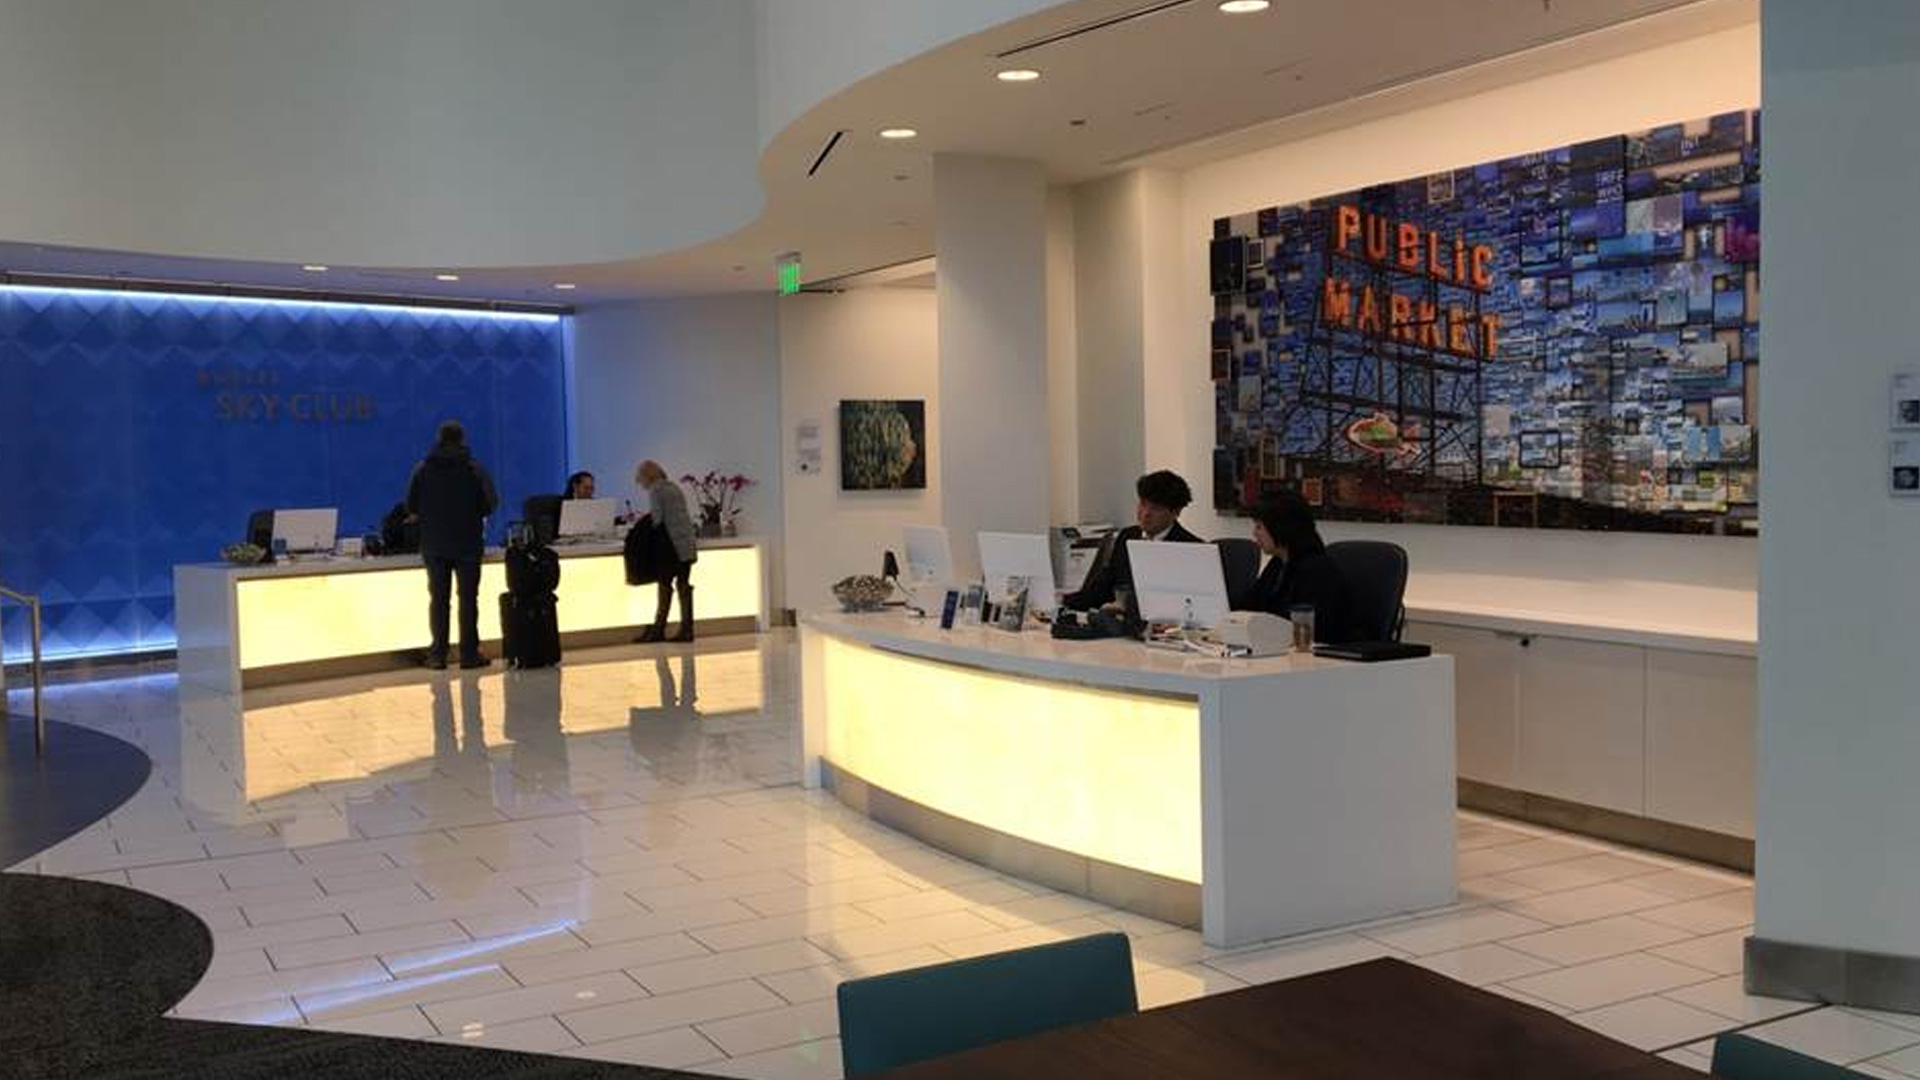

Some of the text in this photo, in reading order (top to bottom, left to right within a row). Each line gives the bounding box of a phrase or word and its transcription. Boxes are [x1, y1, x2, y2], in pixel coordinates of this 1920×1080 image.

[1322, 277, 1502, 362] MARKET
[214, 393, 376, 424] SKY CLUB
